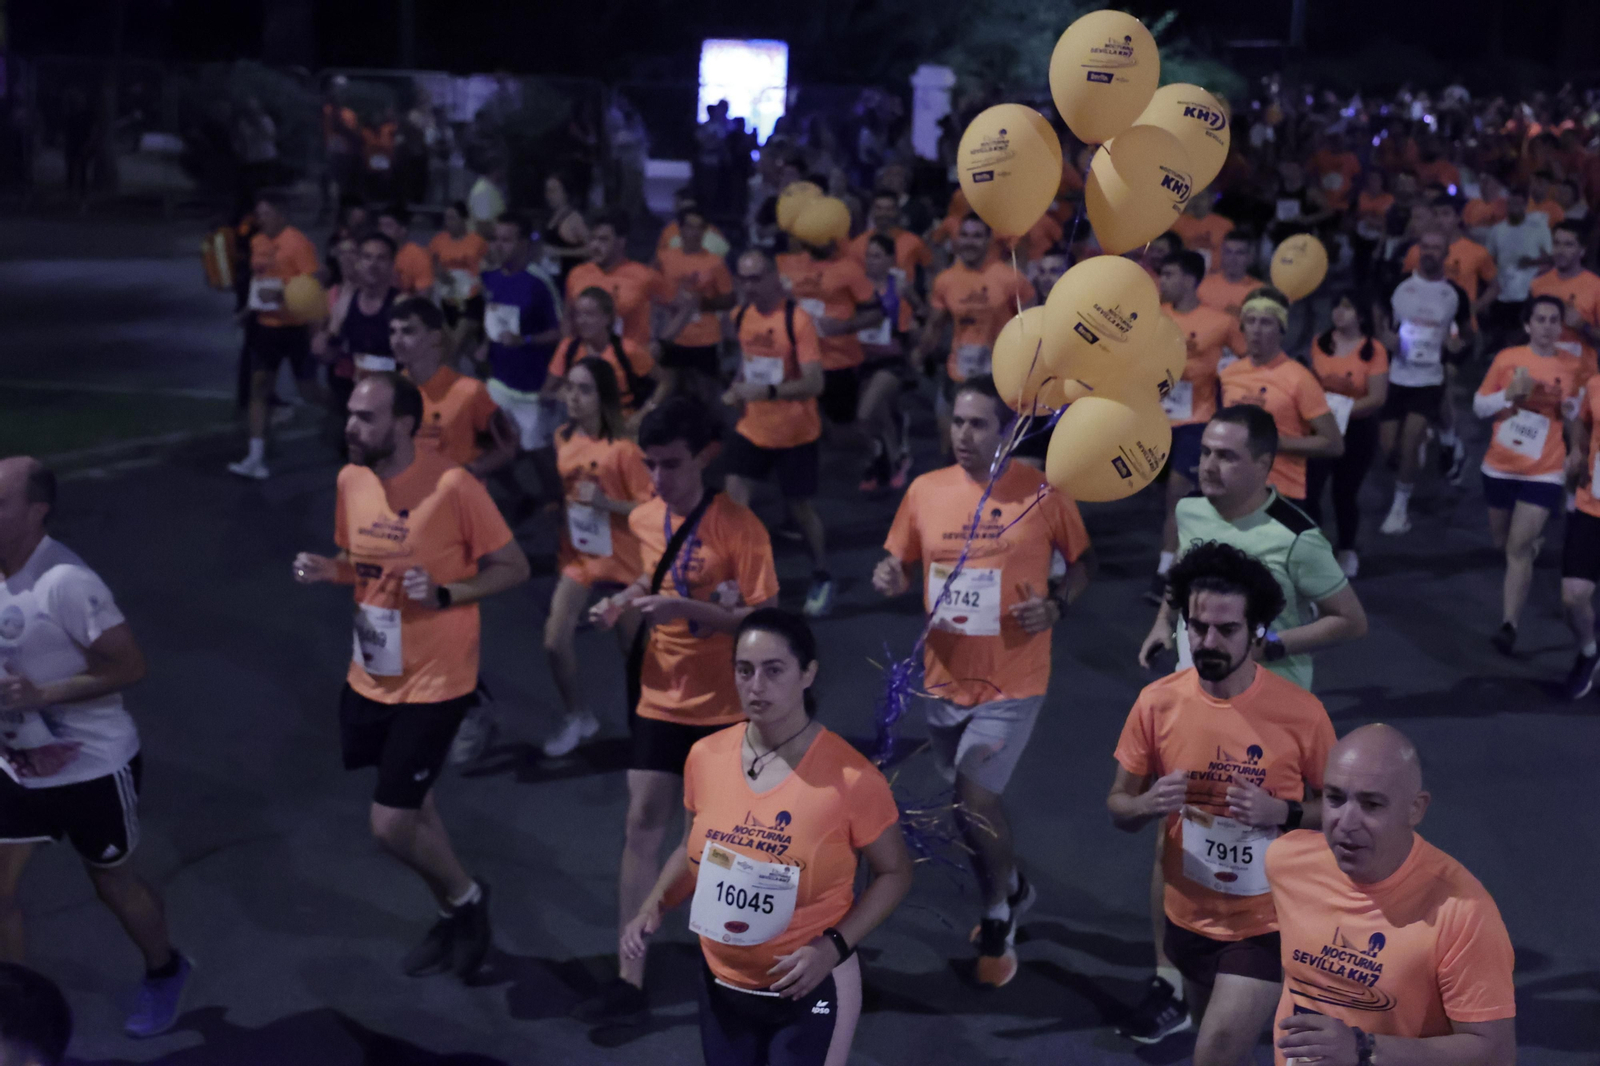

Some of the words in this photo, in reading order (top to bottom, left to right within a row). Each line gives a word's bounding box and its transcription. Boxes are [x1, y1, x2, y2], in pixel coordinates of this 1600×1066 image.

[1186, 769, 1233, 784] EVILLA
[1208, 761, 1267, 777] NOCTURNA
[705, 828, 755, 848] SEVILLA
[732, 825, 792, 845] NOCTURNA
[1205, 838, 1253, 864] 7915
[716, 881, 774, 914] 16045
[1292, 949, 1346, 977] SEVILLA
[1320, 945, 1384, 974] NOCTURNA
